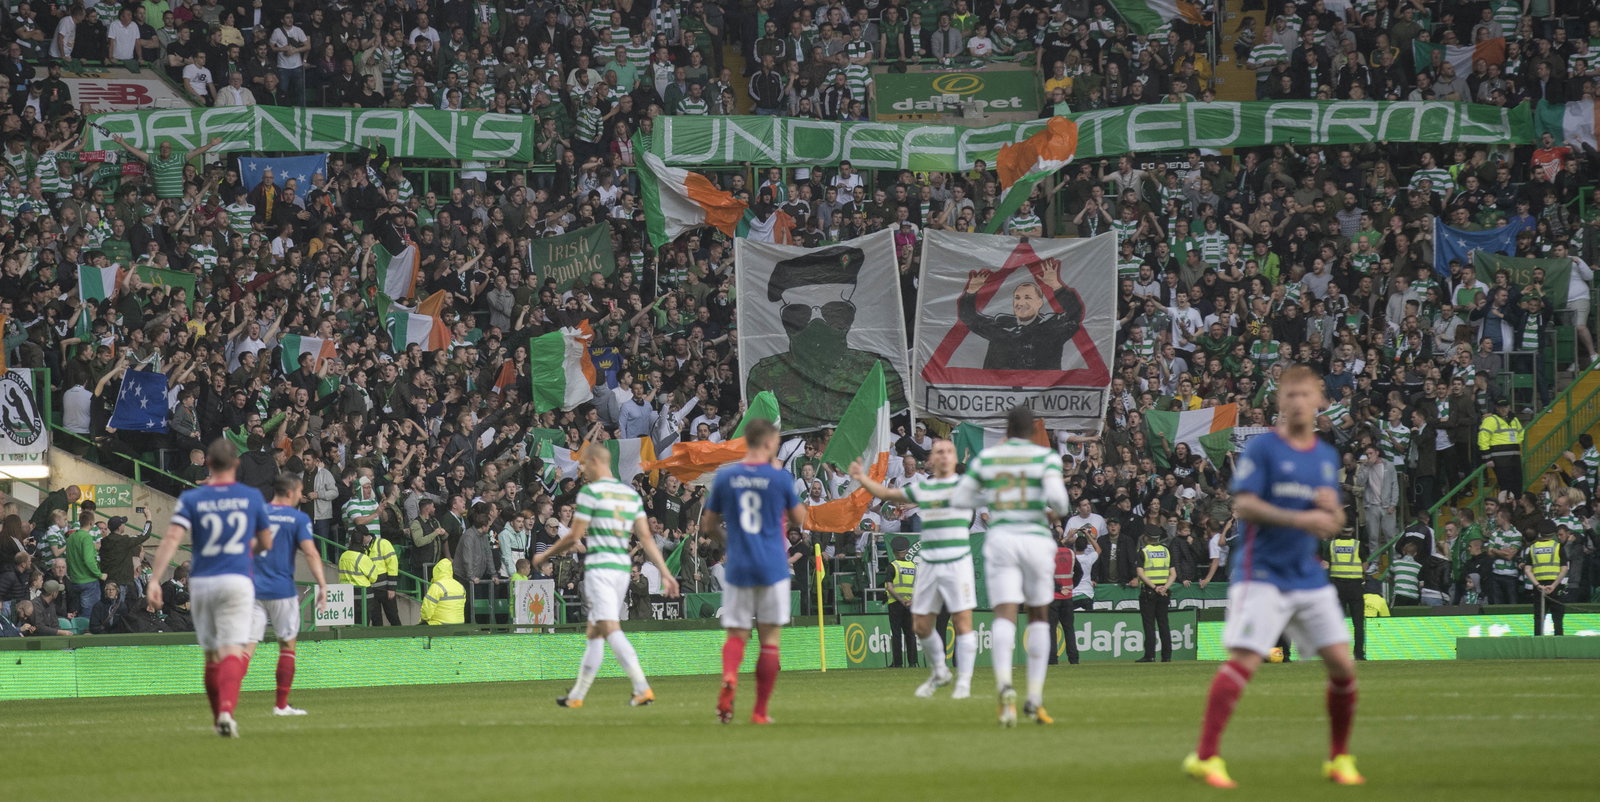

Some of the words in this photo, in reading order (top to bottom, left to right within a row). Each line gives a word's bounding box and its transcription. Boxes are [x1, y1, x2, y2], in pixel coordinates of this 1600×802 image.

[892, 93, 1023, 112] dabet
[1264, 100, 1511, 145] ARMY
[8, 372, 28, 392] CELTIC
[937, 394, 1016, 412] RODGERS
[1023, 396, 1039, 410] AT
[1042, 394, 1092, 411] WORK
[995, 470, 1029, 511] 21
[739, 490, 762, 534] 8
[201, 512, 247, 557] 22
[900, 567, 915, 575] POLIC
[326, 590, 344, 602] Exit
[316, 608, 339, 620] Gate
[342, 606, 354, 620] 14
